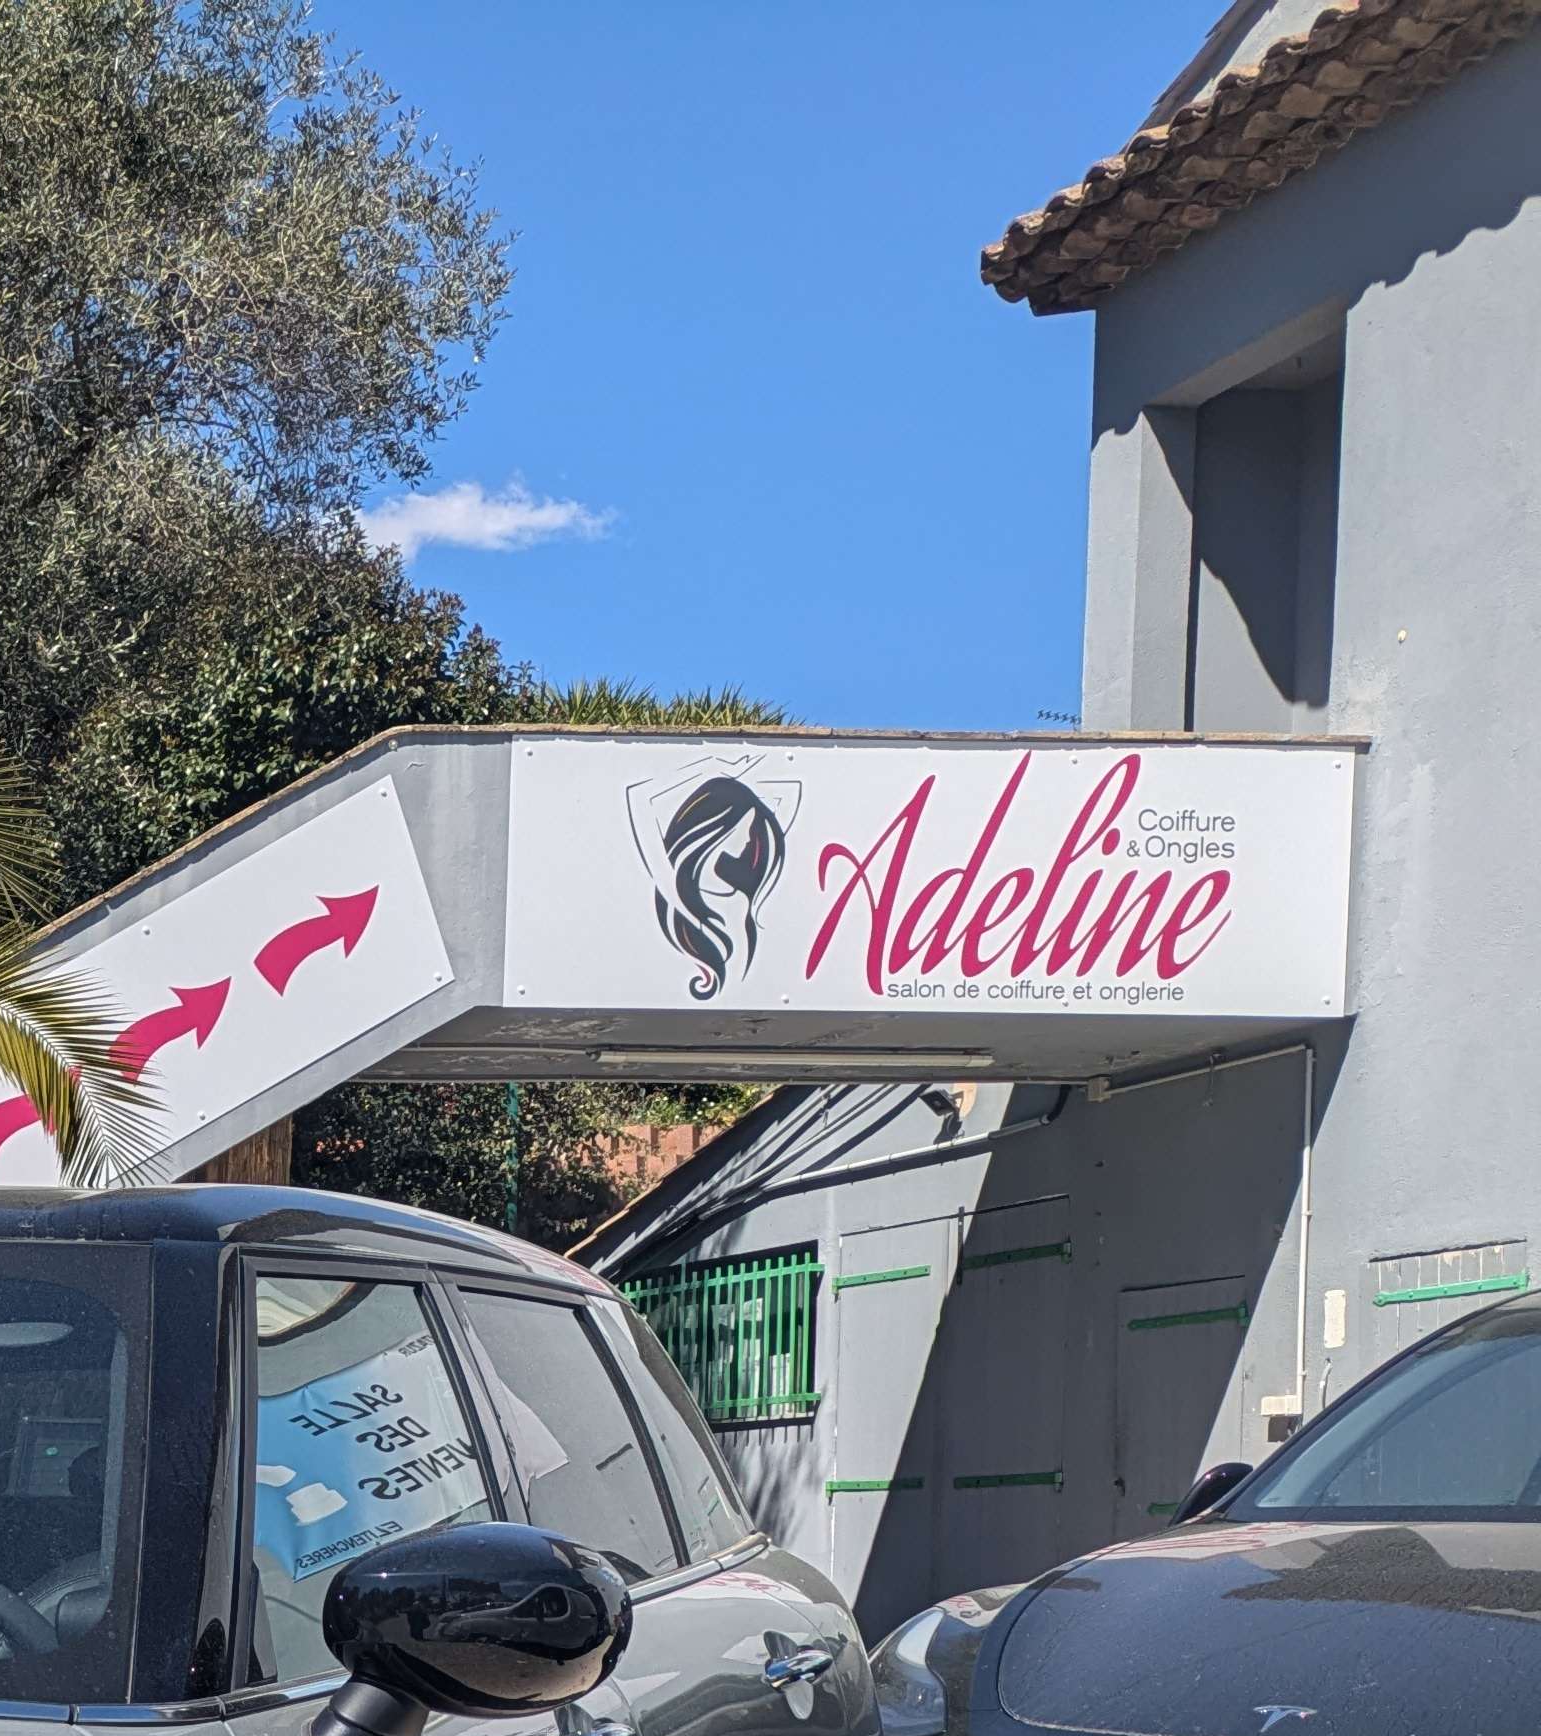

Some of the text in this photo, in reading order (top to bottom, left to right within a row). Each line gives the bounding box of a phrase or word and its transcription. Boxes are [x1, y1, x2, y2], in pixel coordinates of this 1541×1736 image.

[1138, 808, 1236, 832] Coiffure
[1126, 835, 1235, 863] & Ongles
[806, 749, 1233, 995] Adeline
[887, 979, 1184, 1005] salon de coiffure et onglerie
